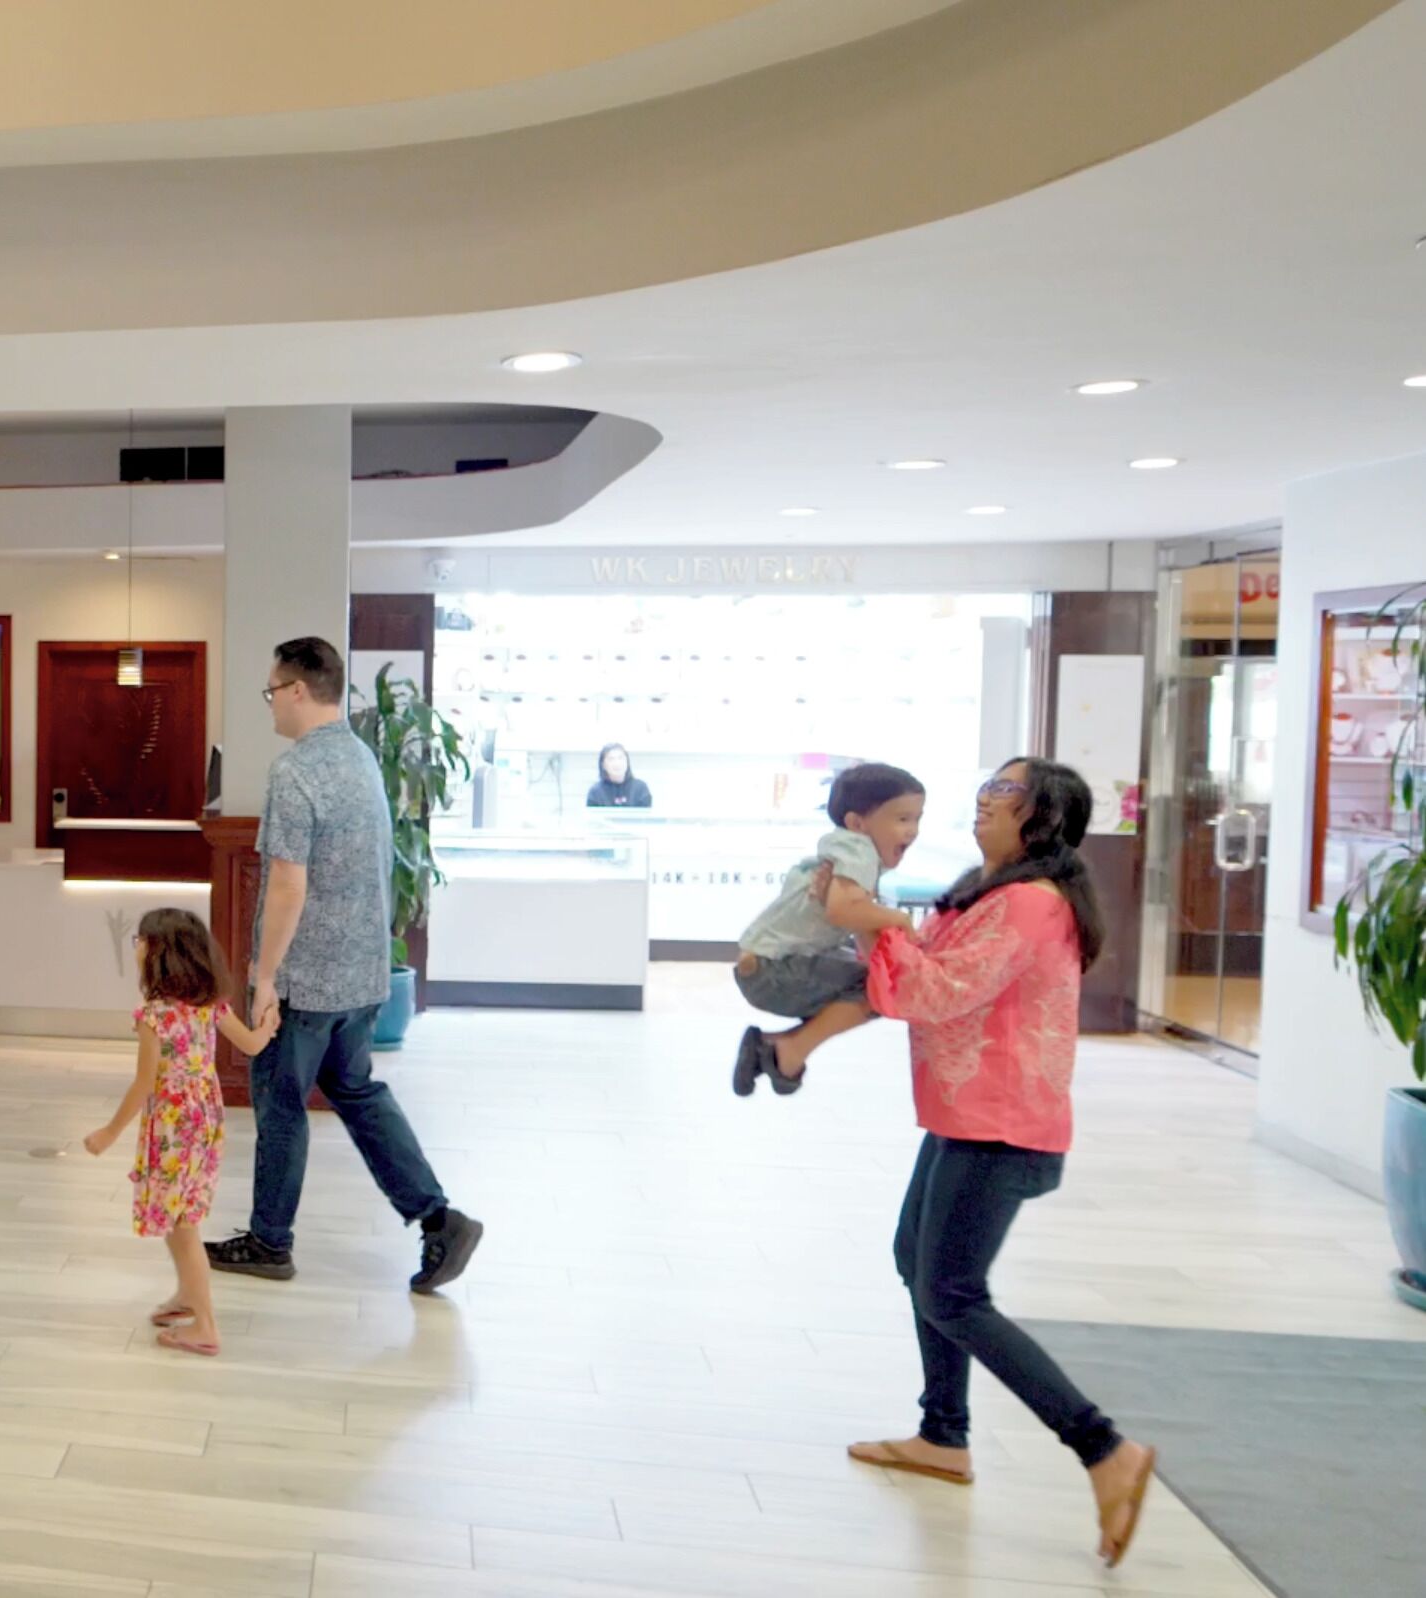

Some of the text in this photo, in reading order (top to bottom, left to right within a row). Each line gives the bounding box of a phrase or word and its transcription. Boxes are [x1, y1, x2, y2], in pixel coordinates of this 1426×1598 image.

[590, 556, 861, 585] WK JEWELRY
[651, 871, 684, 885] 14K
[708, 871, 742, 885] 18K
